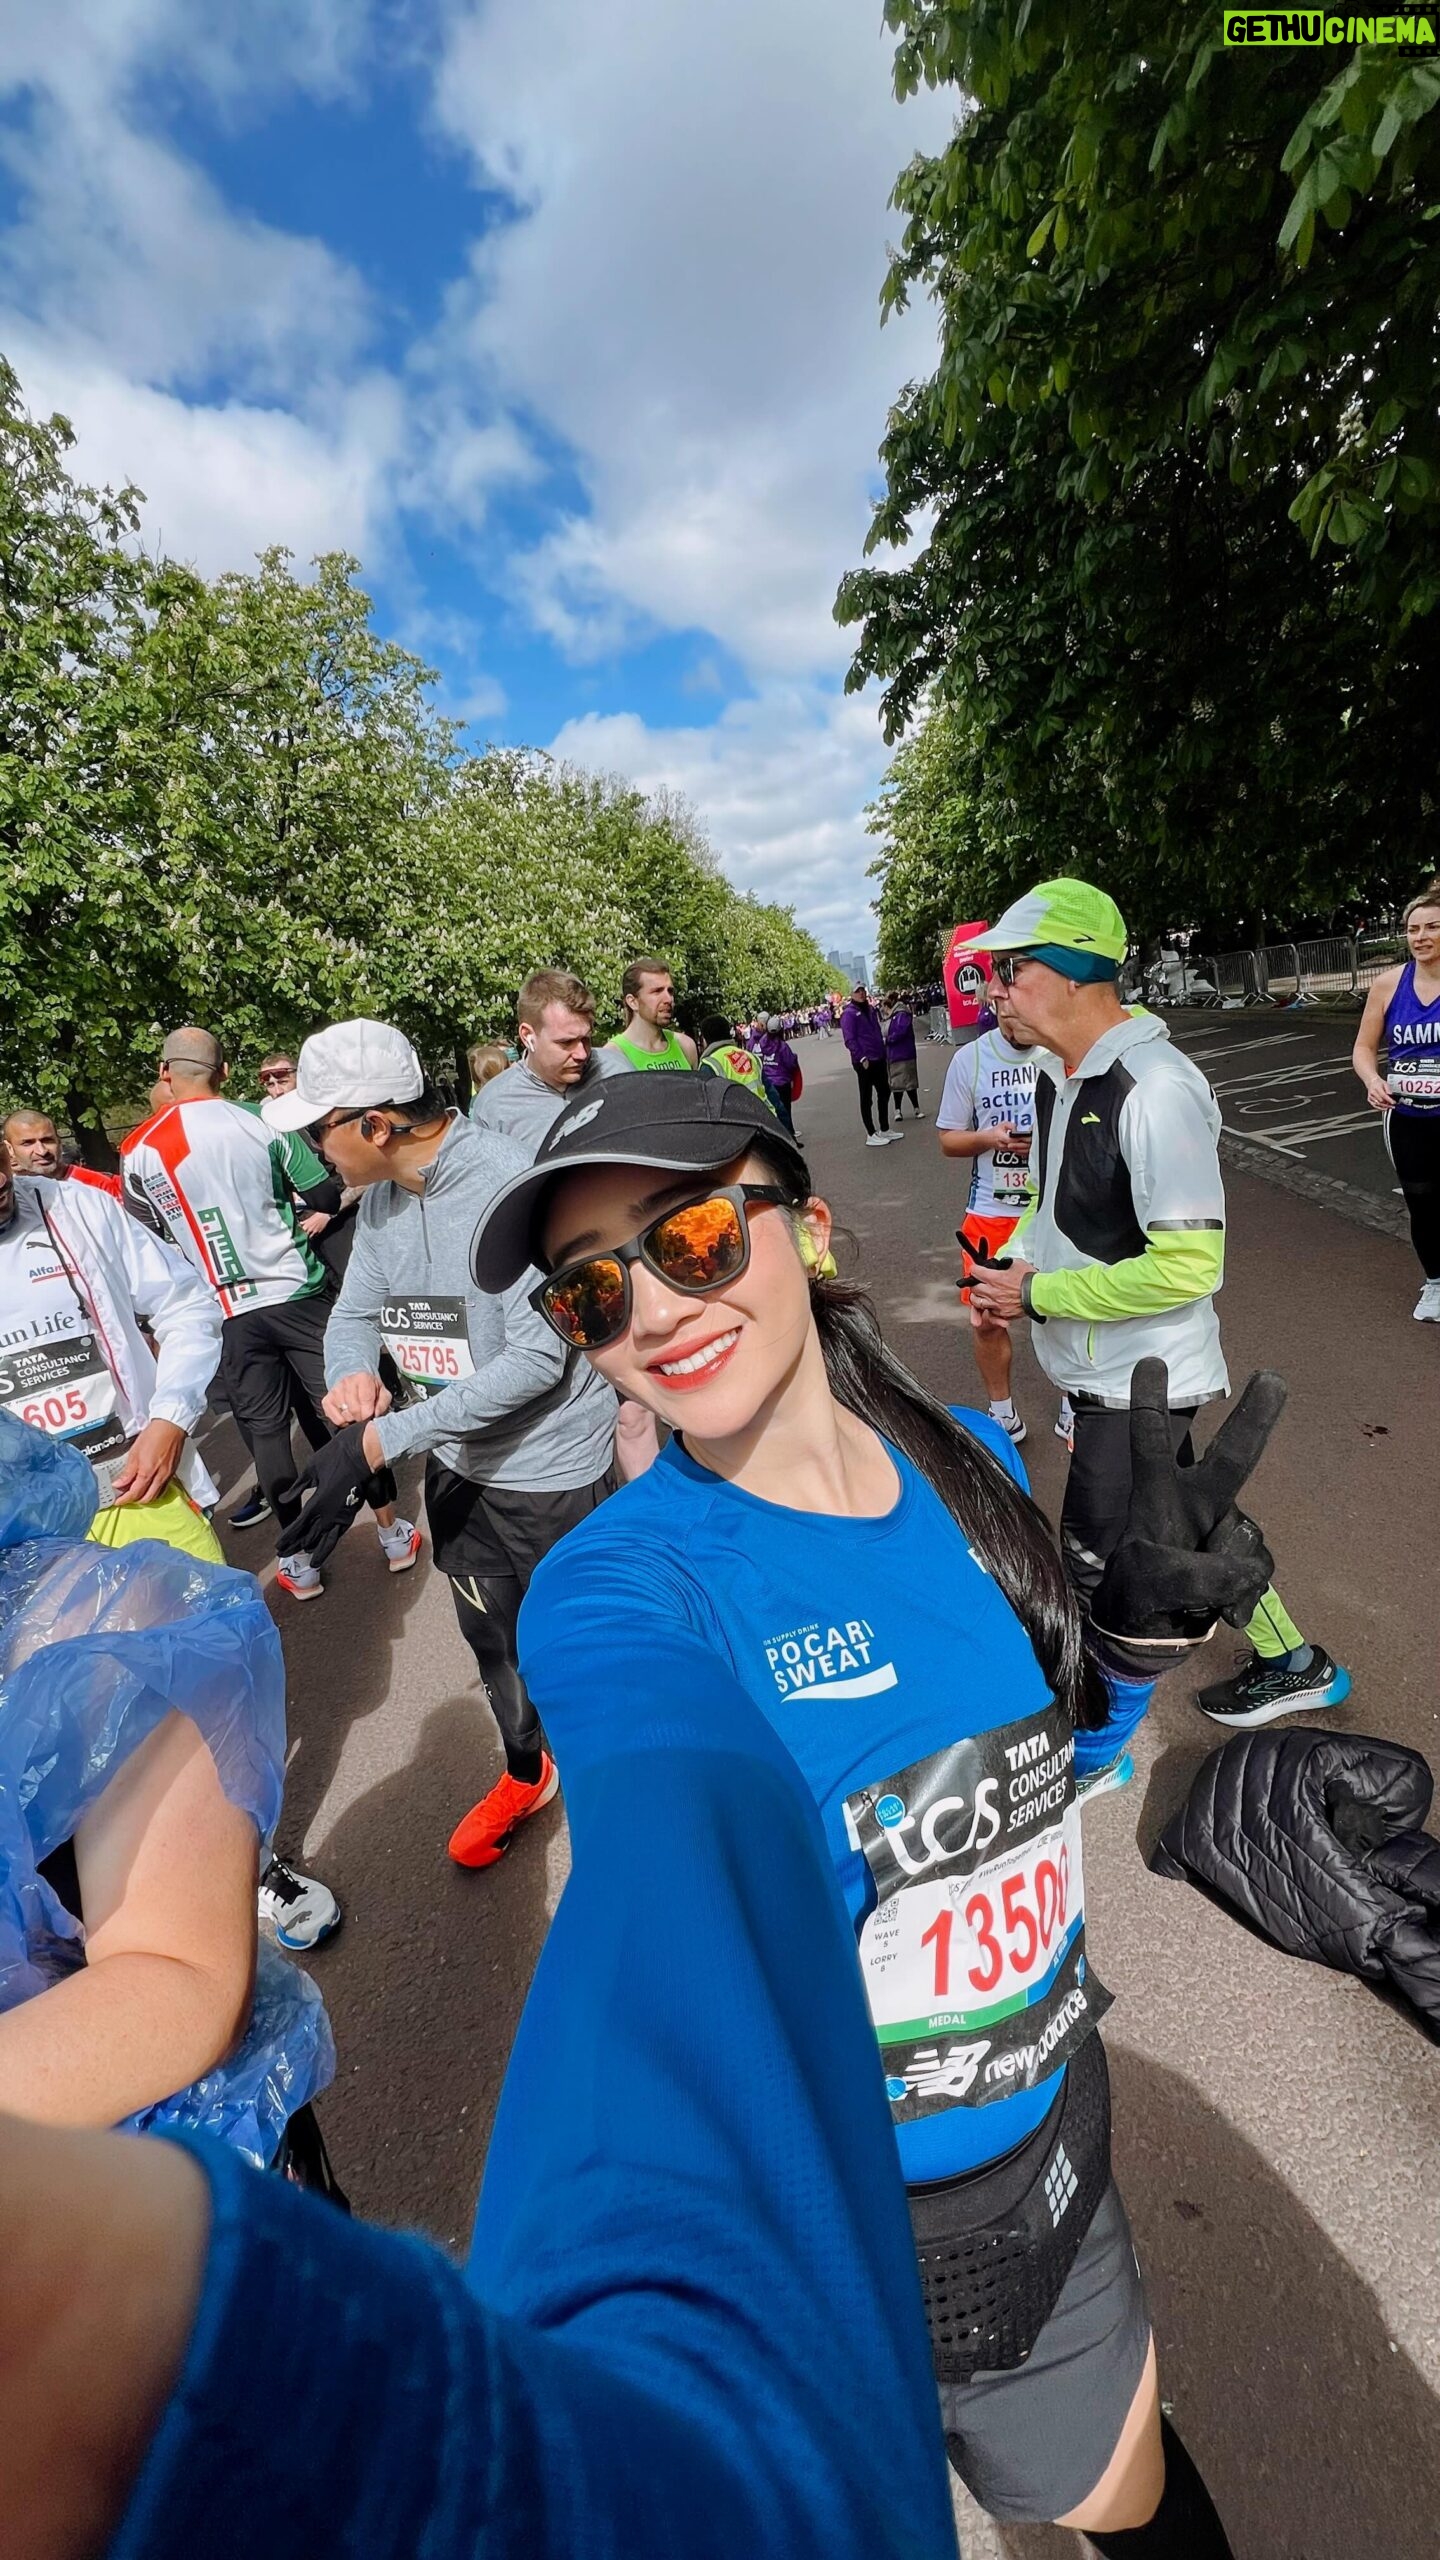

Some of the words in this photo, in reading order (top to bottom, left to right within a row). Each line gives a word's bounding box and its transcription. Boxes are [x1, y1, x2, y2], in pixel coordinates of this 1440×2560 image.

[1393, 1061, 1417, 1073] tcs
[992, 1067, 1037, 1088] FRAN
[1398, 1080, 1440, 1094] 10252
[982, 1089, 1032, 1109] activ
[996, 1151, 1019, 1165] tcs
[408, 1302, 431, 1311] TATA
[411, 1312, 459, 1321] CONSULTANCY
[30, 1311, 76, 1338] Life
[413, 1321, 444, 1330] SERVICES
[13, 1352, 48, 1368] TATA
[17, 1352, 91, 1378] CONSULTANCY
[397, 1344, 459, 1376] 25795
[20, 1366, 70, 1388] SERVICES
[772, 1629, 797, 1644] SUPPLY
[797, 1623, 820, 1636] DRINK
[766, 1619, 875, 1670] POCARI
[774, 1641, 871, 1693] SWEAT
[1005, 1731, 1050, 1772] TATA
[1006, 1777, 1067, 1832] SERVICES
[884, 1777, 1001, 1875] tcs
[874, 1928, 900, 1941] WAVE
[870, 1953, 898, 1966] LORRY
[928, 2014, 967, 2029] MEDAL
